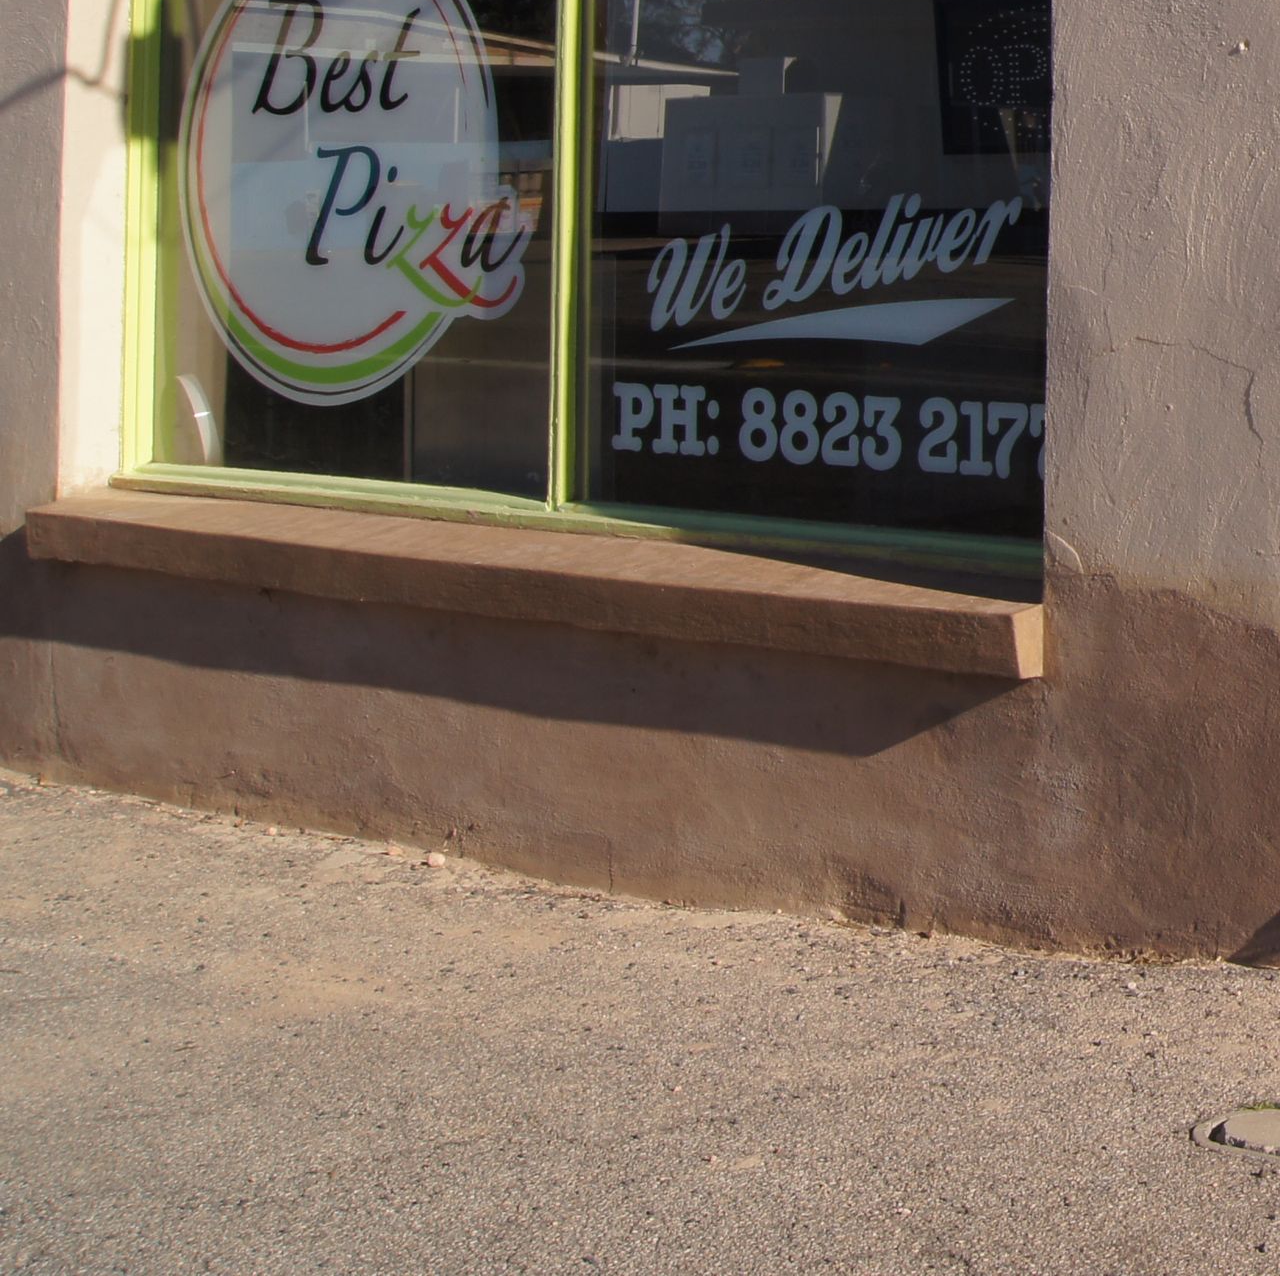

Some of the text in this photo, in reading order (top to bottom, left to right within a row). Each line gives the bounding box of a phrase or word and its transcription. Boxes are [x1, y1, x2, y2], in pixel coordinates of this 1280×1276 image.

[960, 44, 1051, 105] OP
[305, 145, 525, 309] Pizza
[647, 193, 1023, 332] We Deliver
[612, 382, 720, 456] PH:
[739, 389, 902, 471] 8823
